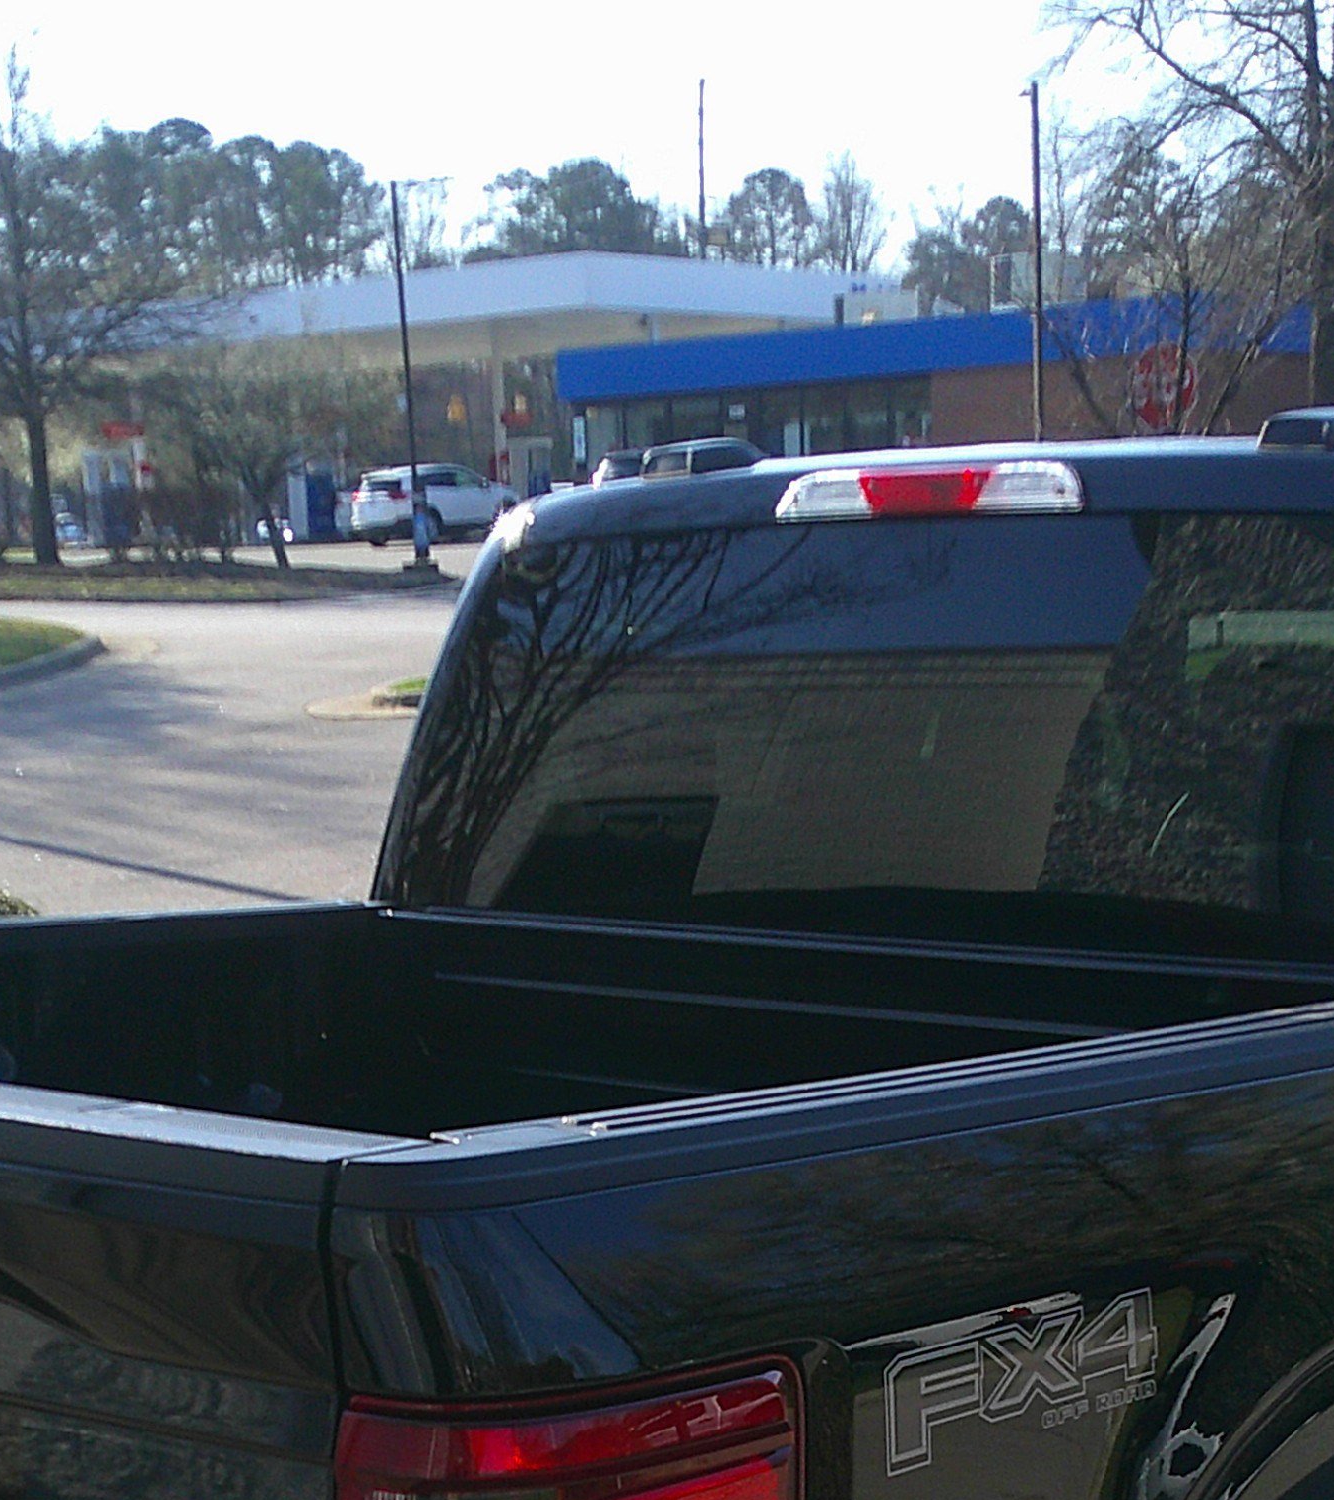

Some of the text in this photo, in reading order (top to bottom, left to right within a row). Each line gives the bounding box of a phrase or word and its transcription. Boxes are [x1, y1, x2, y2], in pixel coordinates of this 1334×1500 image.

[883, 1287, 1158, 1477] FX4
[1041, 1379, 1157, 1430] OFF ROAD
